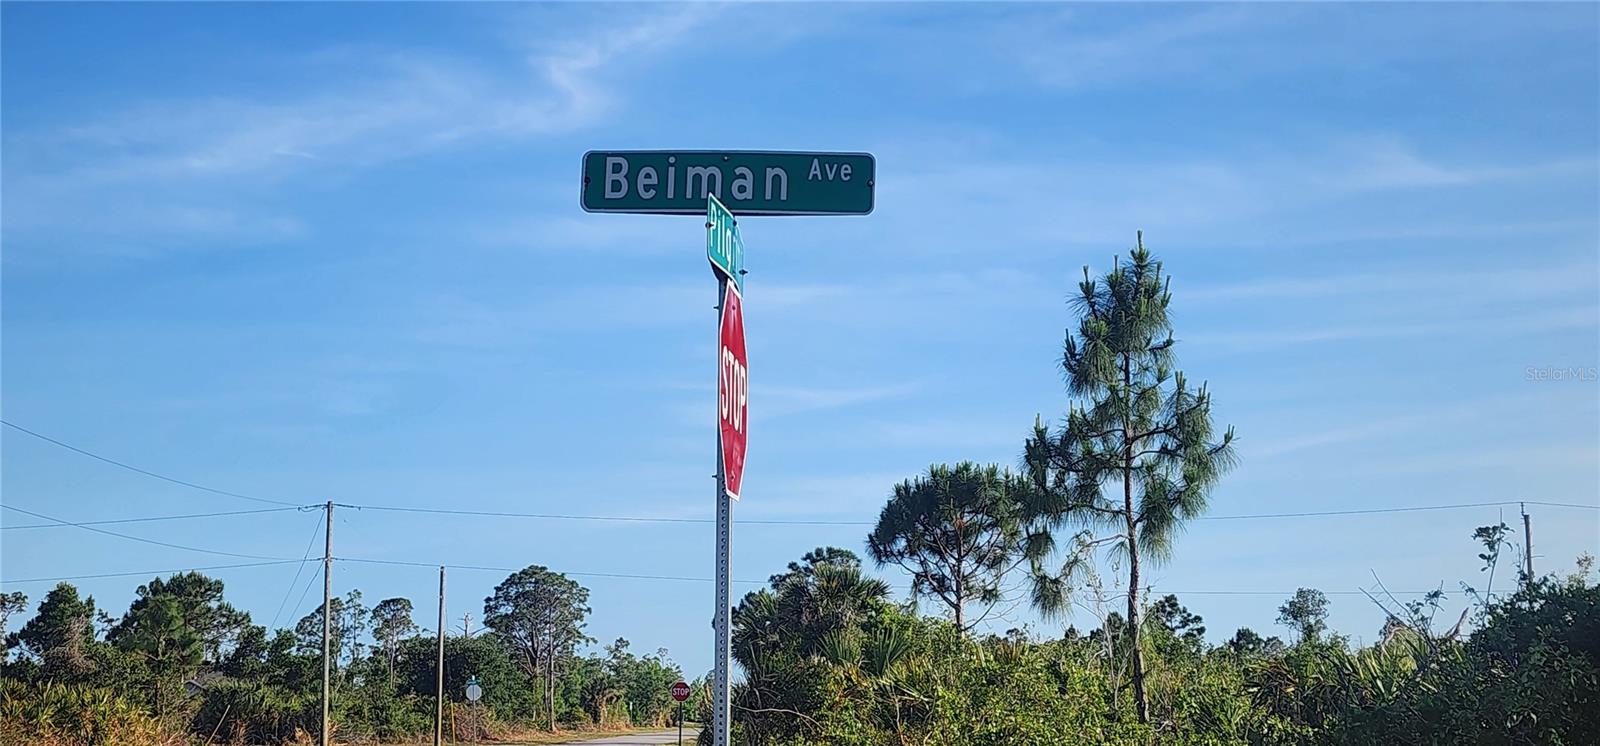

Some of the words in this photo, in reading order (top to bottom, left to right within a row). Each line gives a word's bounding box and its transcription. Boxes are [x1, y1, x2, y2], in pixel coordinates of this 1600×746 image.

[604, 156, 788, 200] Beiman
[808, 158, 852, 181] Ave
[721, 345, 747, 434] STOP
[672, 687, 690, 697] STOP
